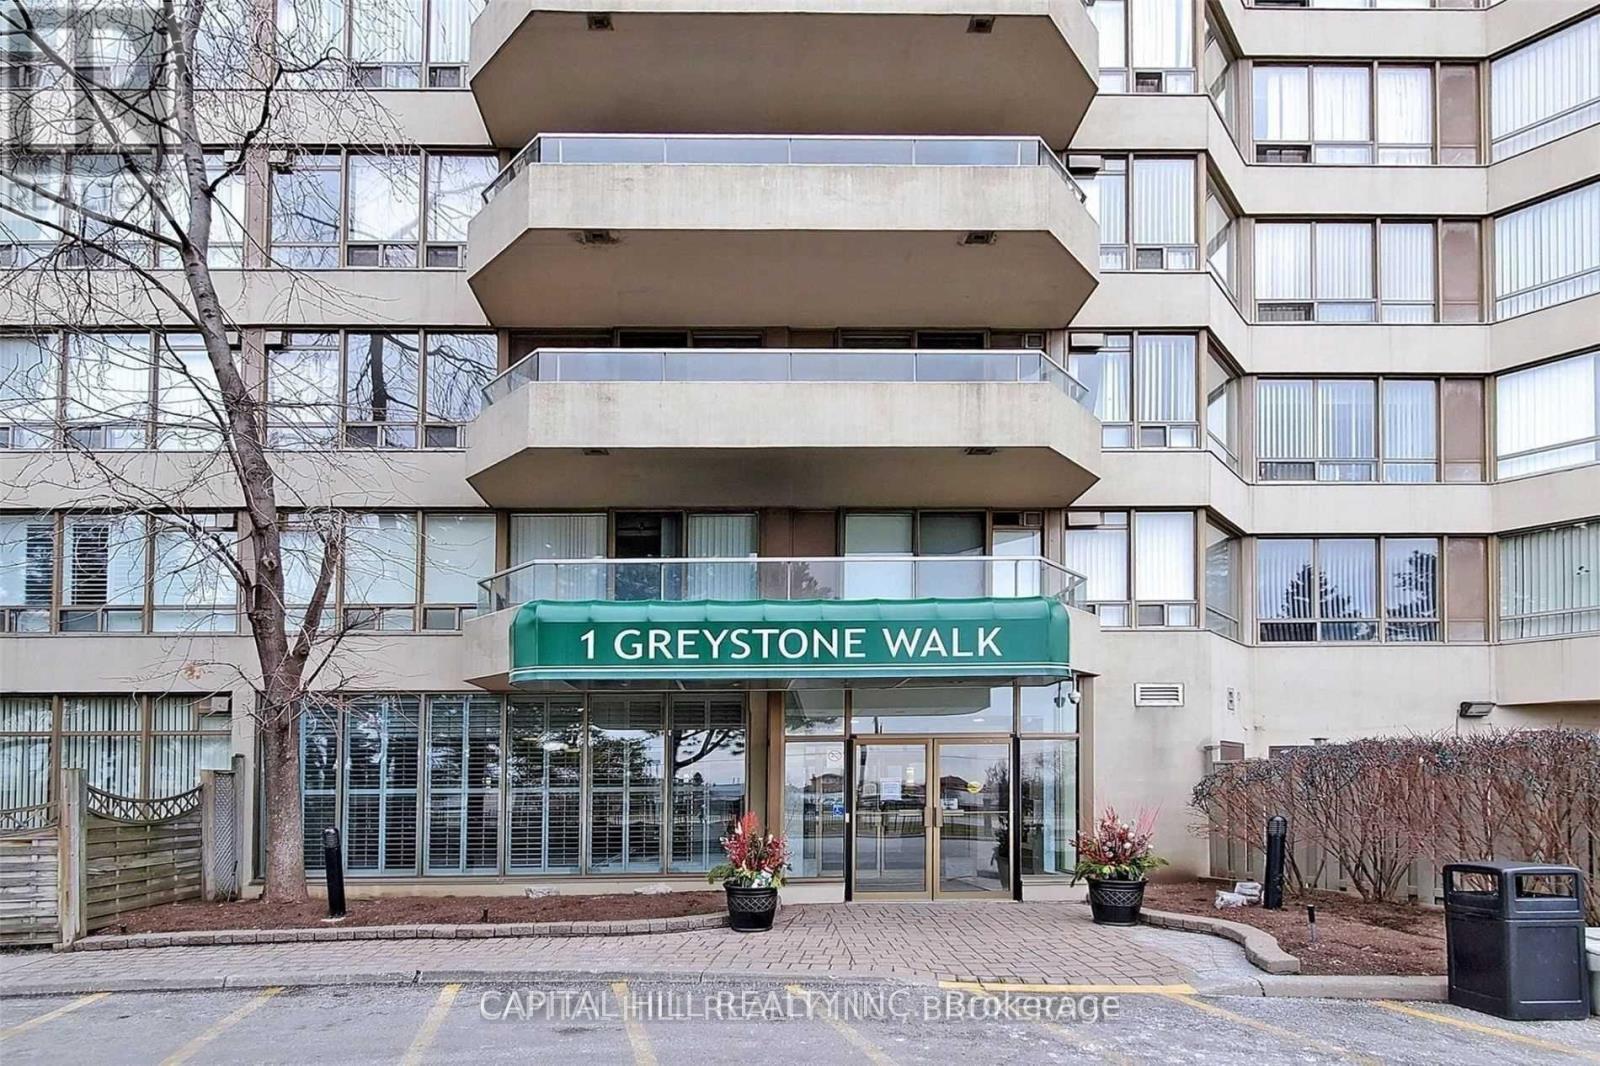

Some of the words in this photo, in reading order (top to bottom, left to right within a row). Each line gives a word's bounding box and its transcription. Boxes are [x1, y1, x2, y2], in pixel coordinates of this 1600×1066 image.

[580, 630, 596, 659] 1
[613, 628, 867, 661] GREYSTONE
[881, 626, 1003, 658] WALK
